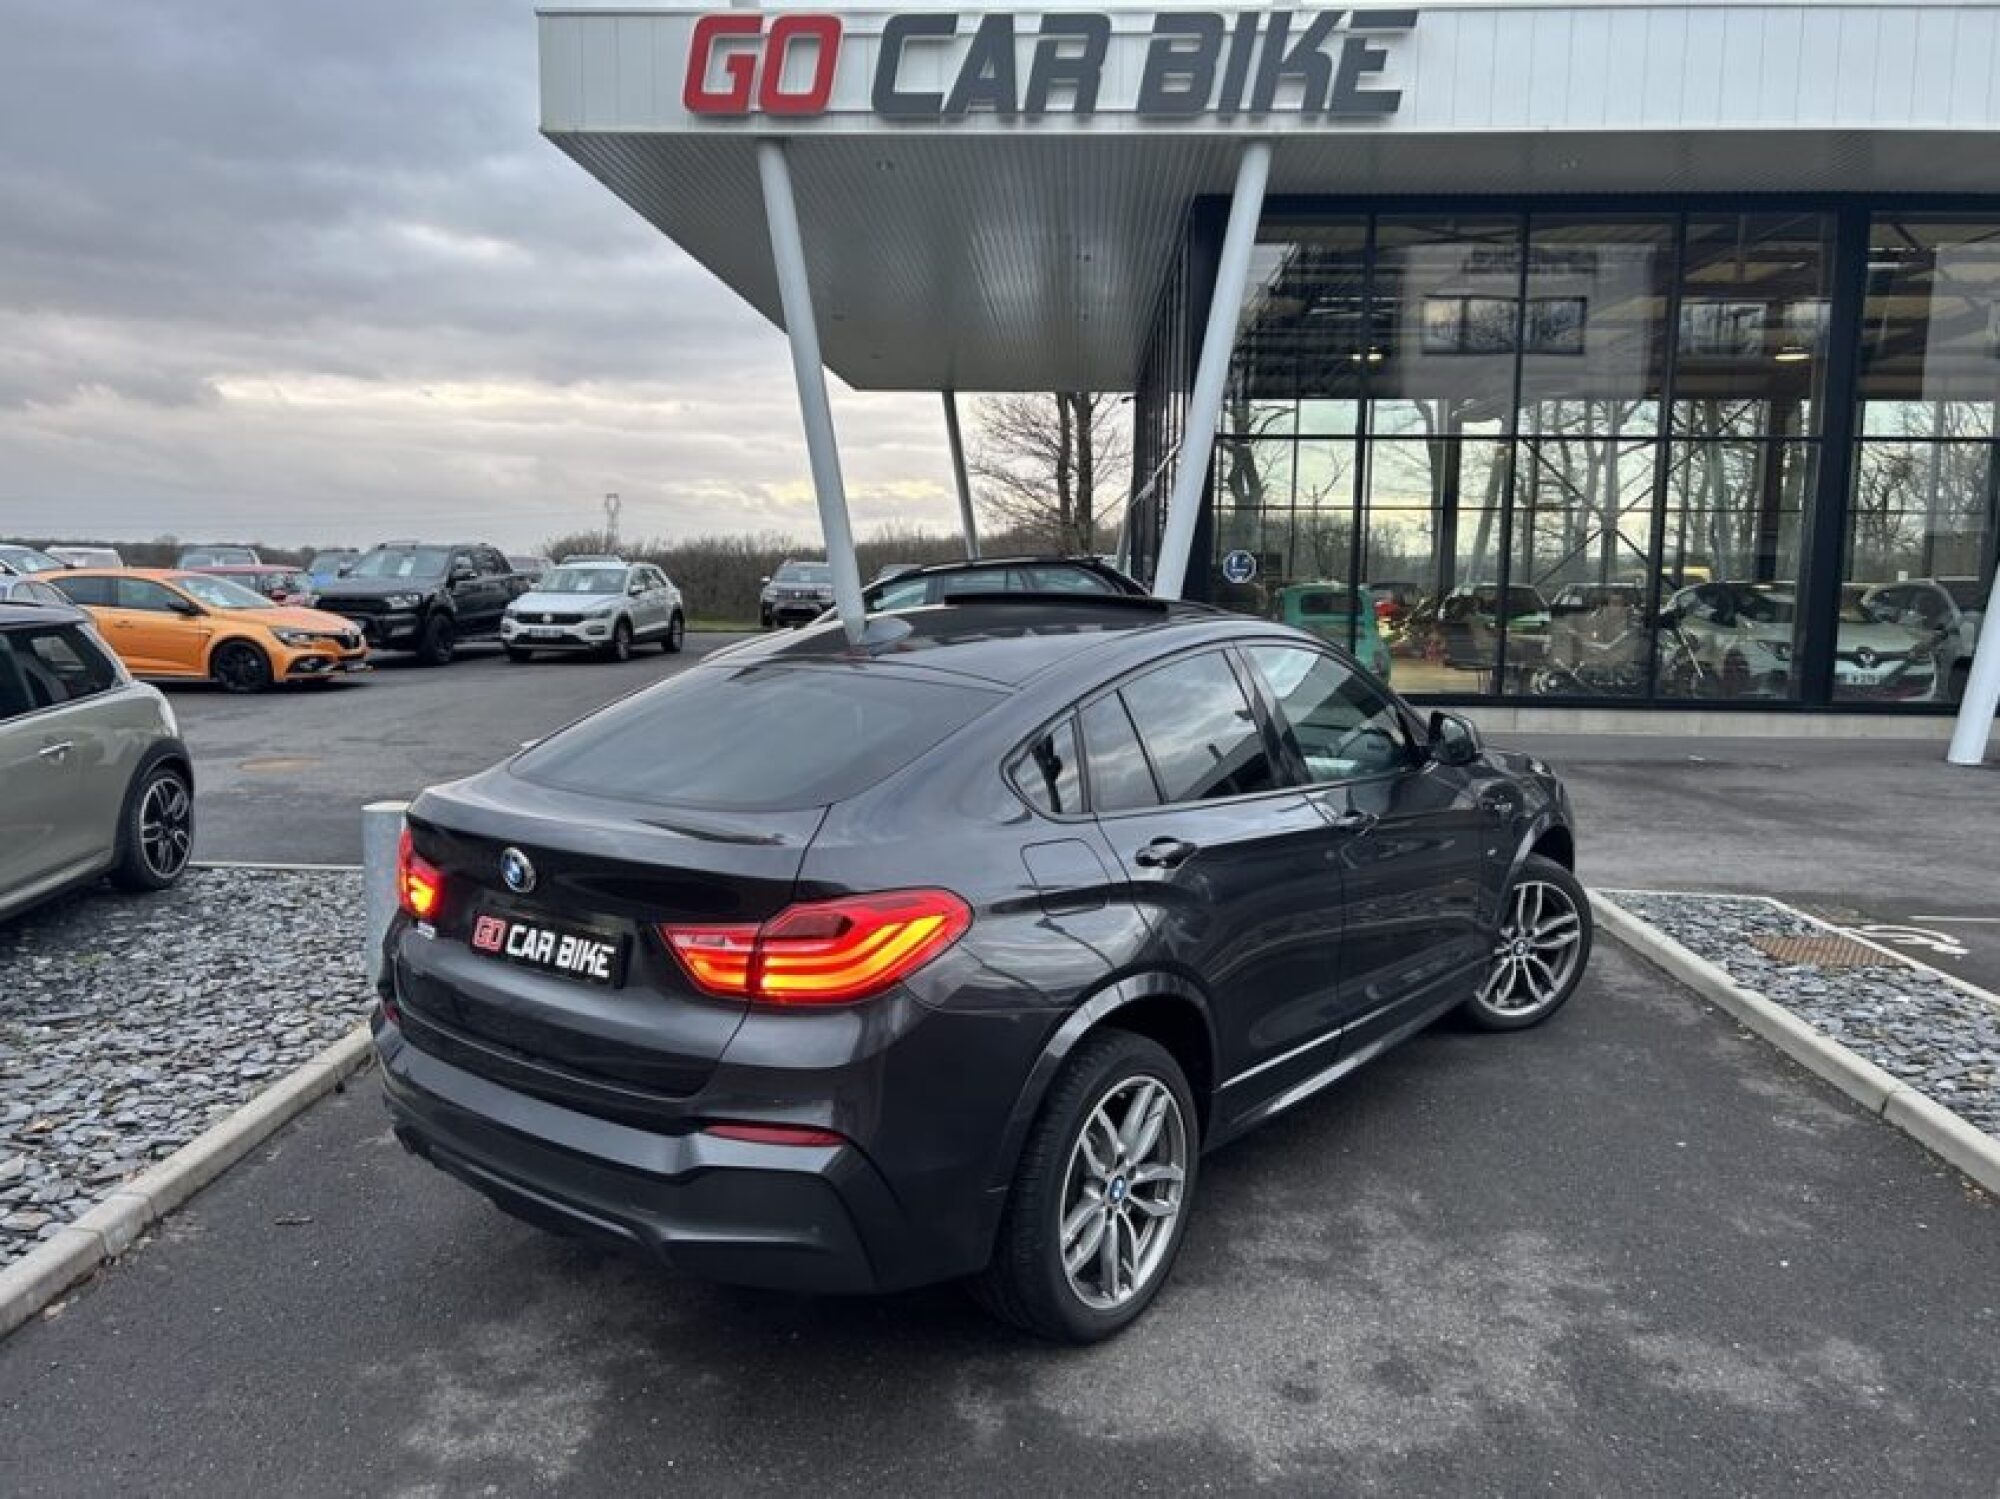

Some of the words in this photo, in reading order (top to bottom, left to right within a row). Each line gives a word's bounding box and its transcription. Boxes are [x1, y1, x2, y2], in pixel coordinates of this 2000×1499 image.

[682, 13, 843, 116] GO
[871, 12, 1112, 118] CAR
[1137, 10, 1418, 117] BIKE
[472, 915, 507, 952] GO
[506, 924, 556, 964] CAR
[555, 934, 616, 979] BIKE
